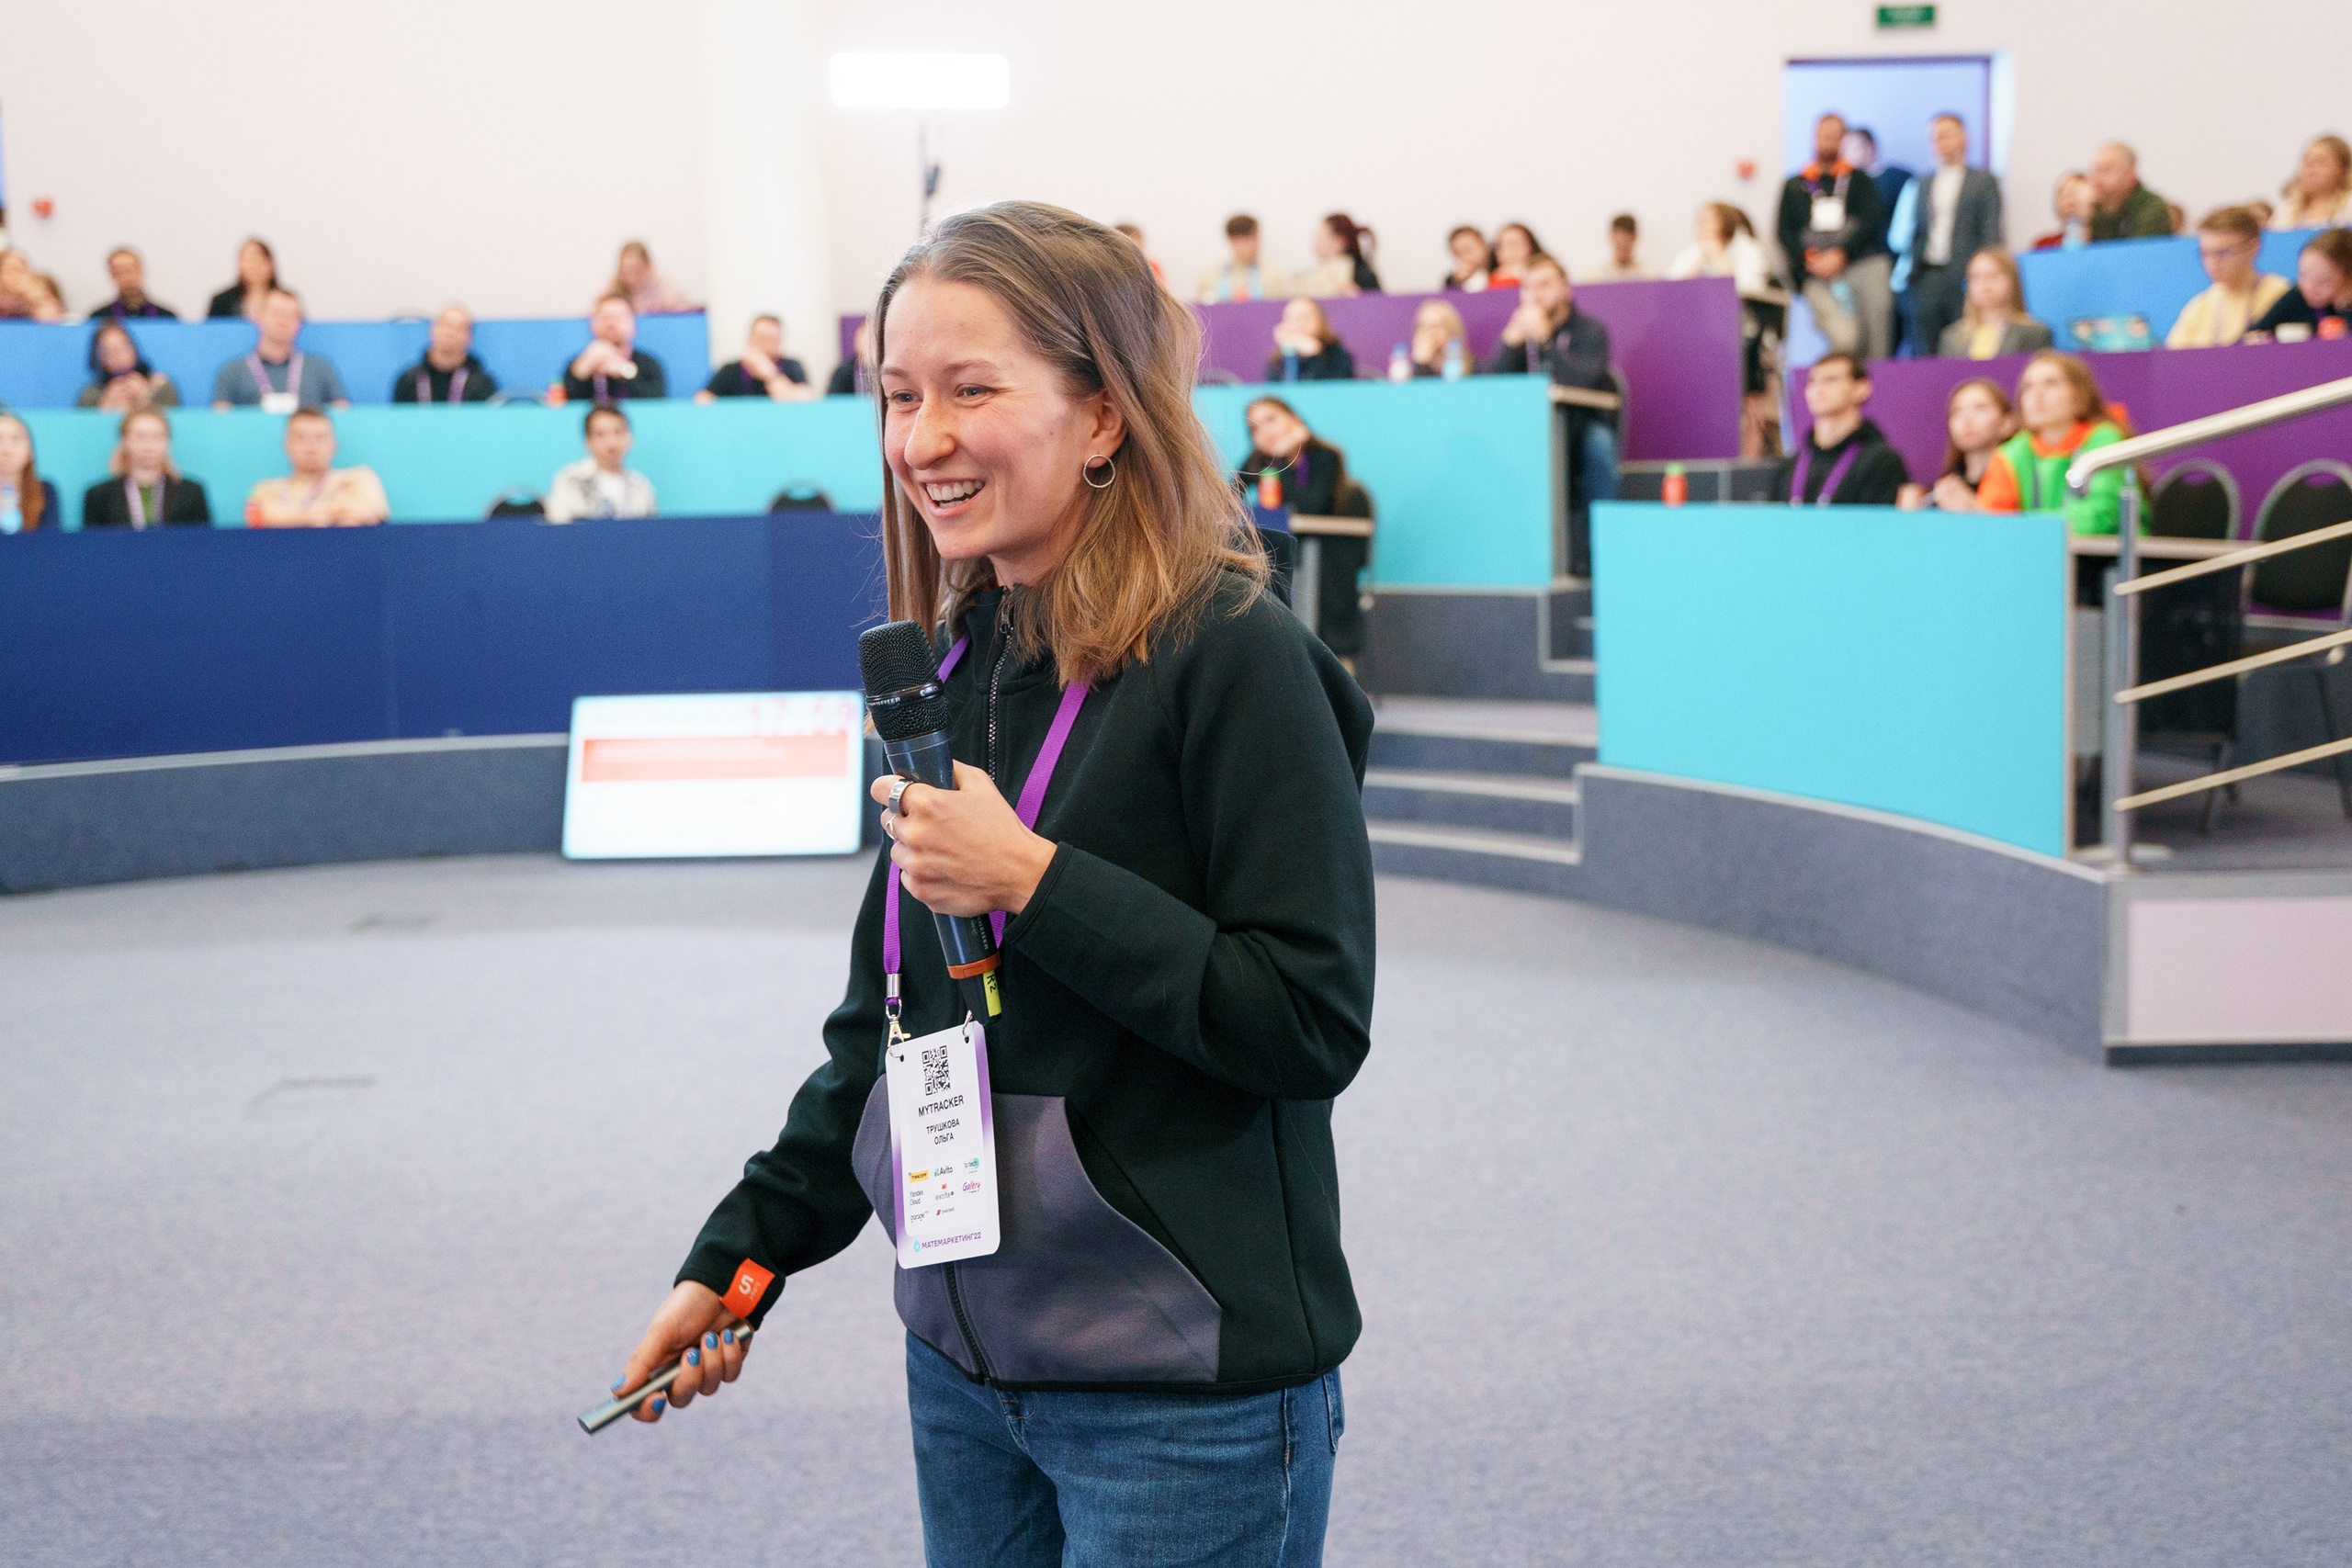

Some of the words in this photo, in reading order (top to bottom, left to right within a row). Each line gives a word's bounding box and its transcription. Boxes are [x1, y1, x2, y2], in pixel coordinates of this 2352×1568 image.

[918, 1095, 964, 1117] MYTRACKER
[926, 1118, 960, 1134] ТРУШКОВА
[933, 1133, 955, 1145] ОЛЬГА
[940, 1166, 953, 1175] Avito
[962, 1180, 981, 1193] Gallery
[922, 1232, 981, 1249] МАТЕМАРКЕТИНГ22
